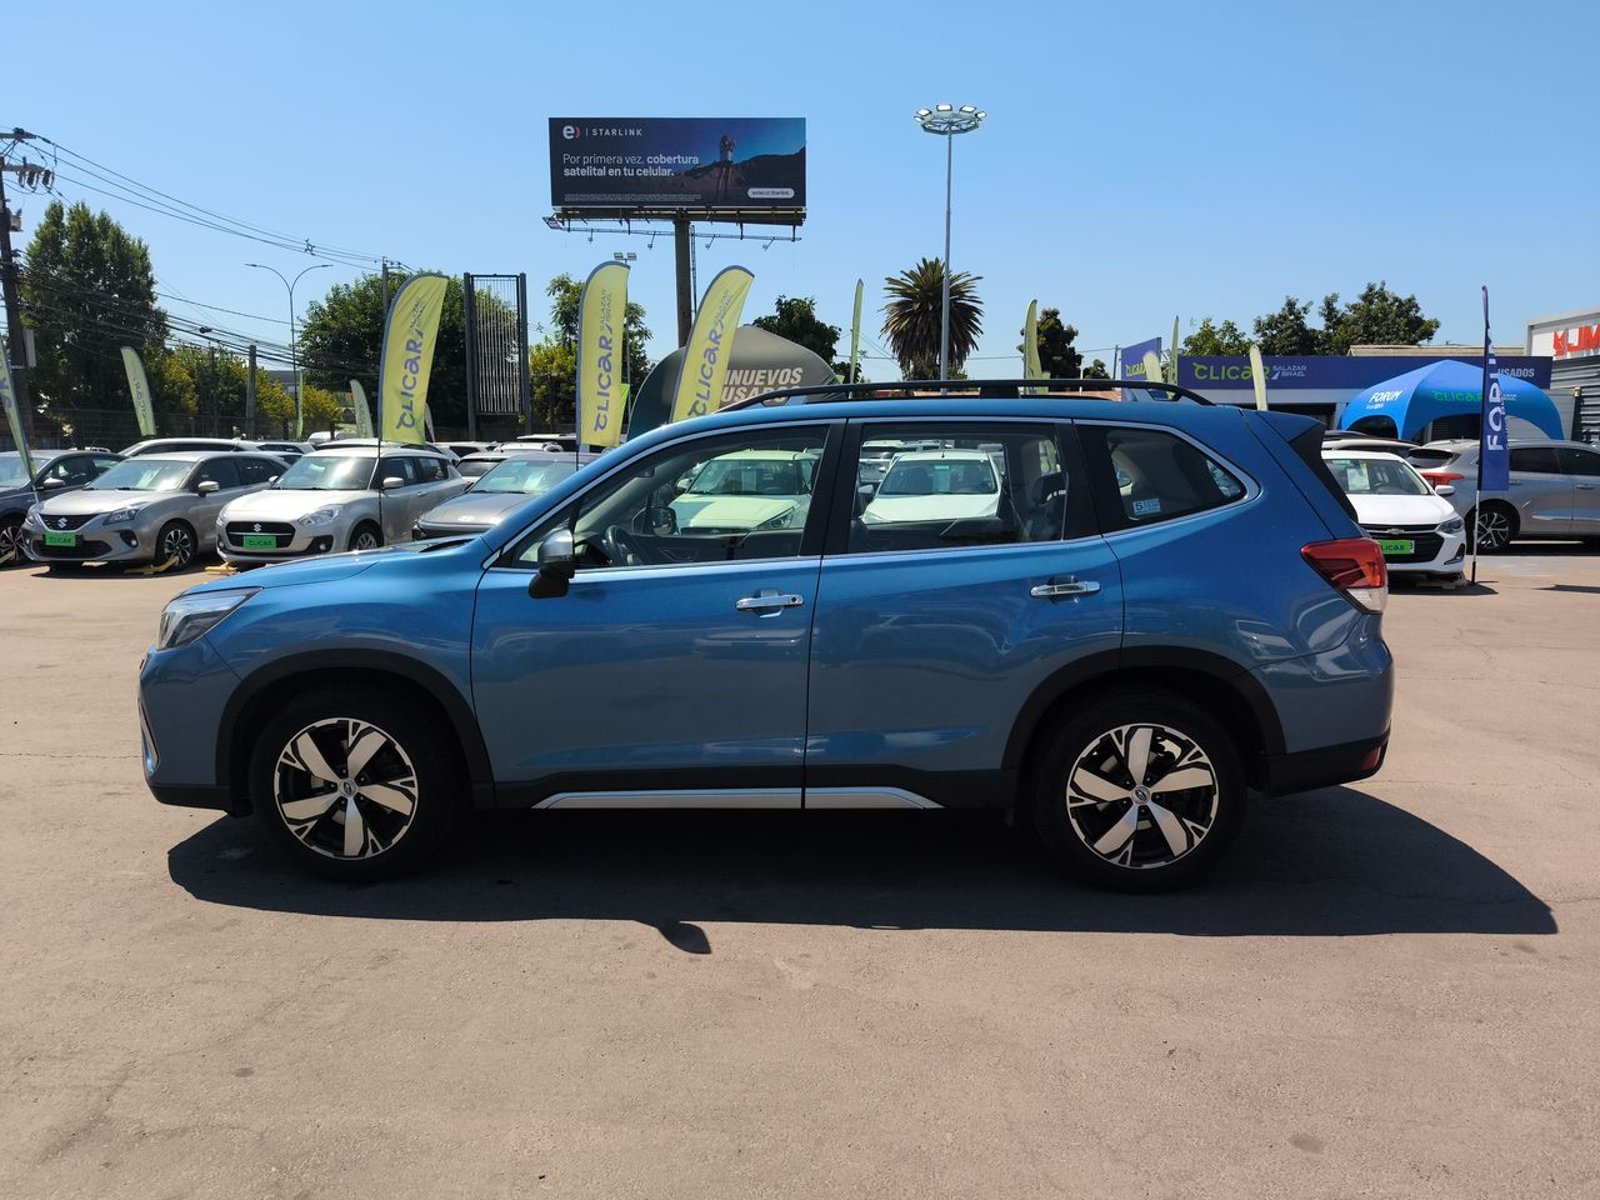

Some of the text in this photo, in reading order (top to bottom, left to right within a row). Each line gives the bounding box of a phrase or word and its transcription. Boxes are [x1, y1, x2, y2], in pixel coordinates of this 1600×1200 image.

[592, 128, 642, 136] STARLINK
[563, 154, 581, 164] Por
[583, 154, 623, 166] primera
[647, 154, 699, 164] cobertura
[563, 166, 675, 176] satelital en tu celular.
[1497, 368, 1535, 378] USADOS
[1369, 390, 1403, 403] FORUM
